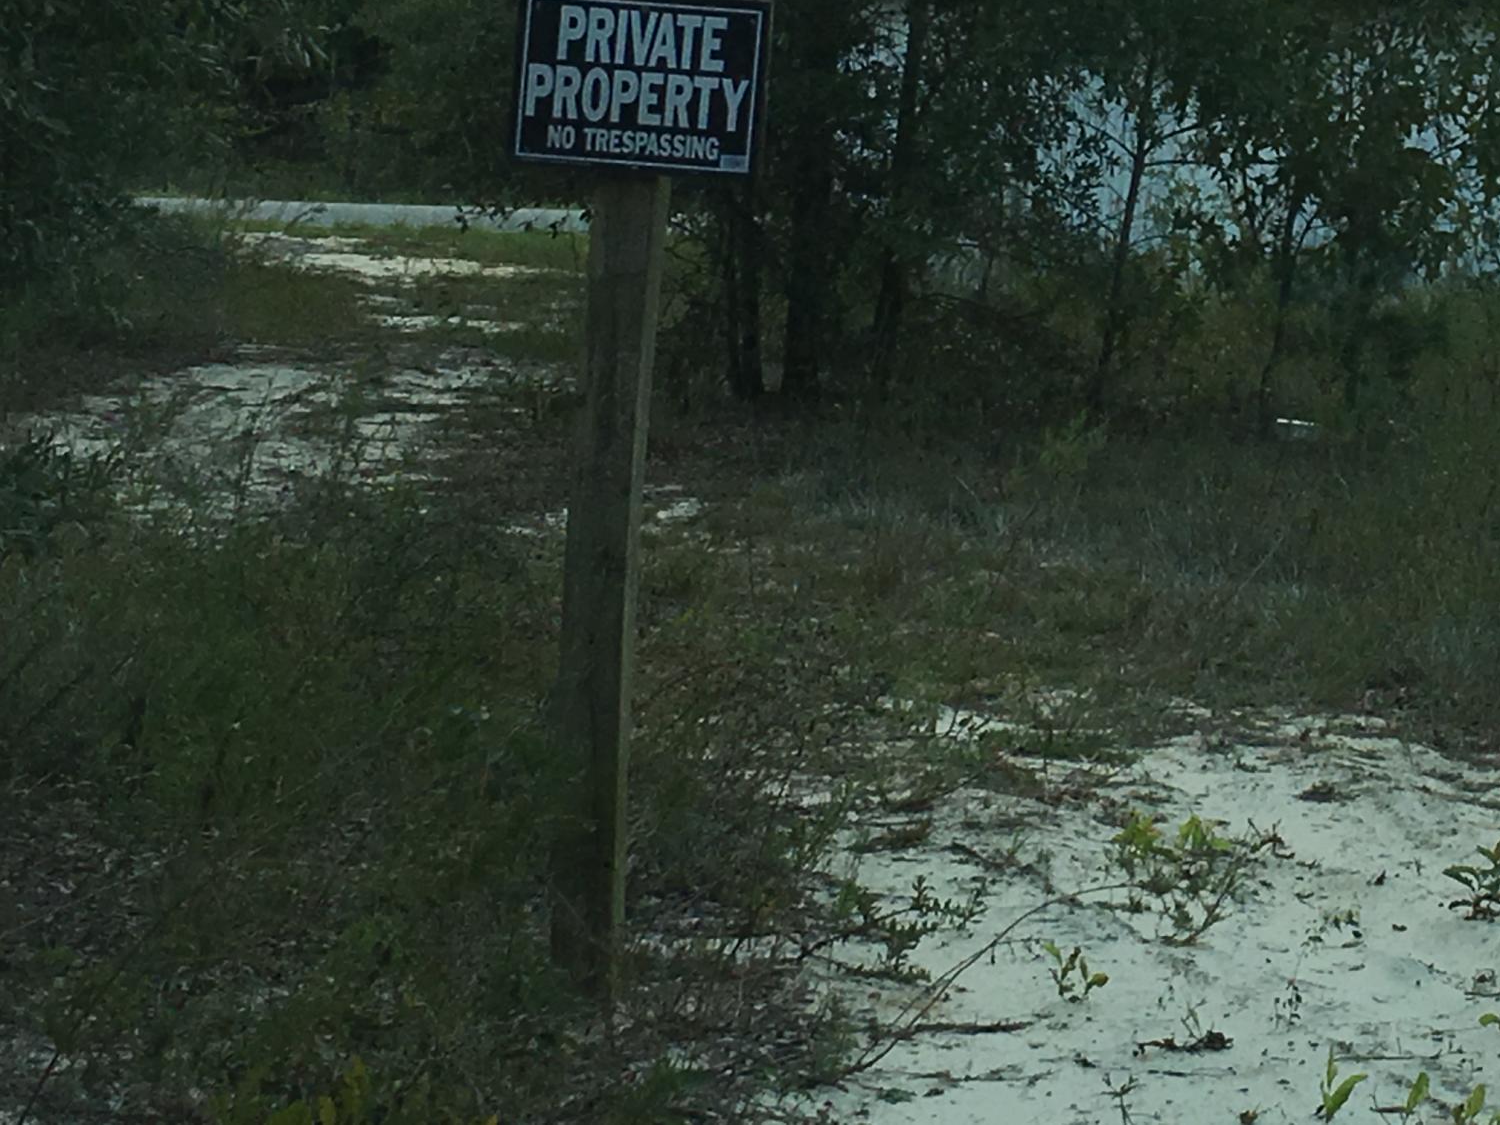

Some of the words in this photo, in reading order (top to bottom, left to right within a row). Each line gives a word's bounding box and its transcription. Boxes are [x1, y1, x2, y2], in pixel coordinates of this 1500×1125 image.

[557, 5, 728, 72] PRIVATE
[525, 63, 749, 132] PROPERTY
[547, 125, 575, 149] NO
[583, 127, 720, 160] TRESPASSING
